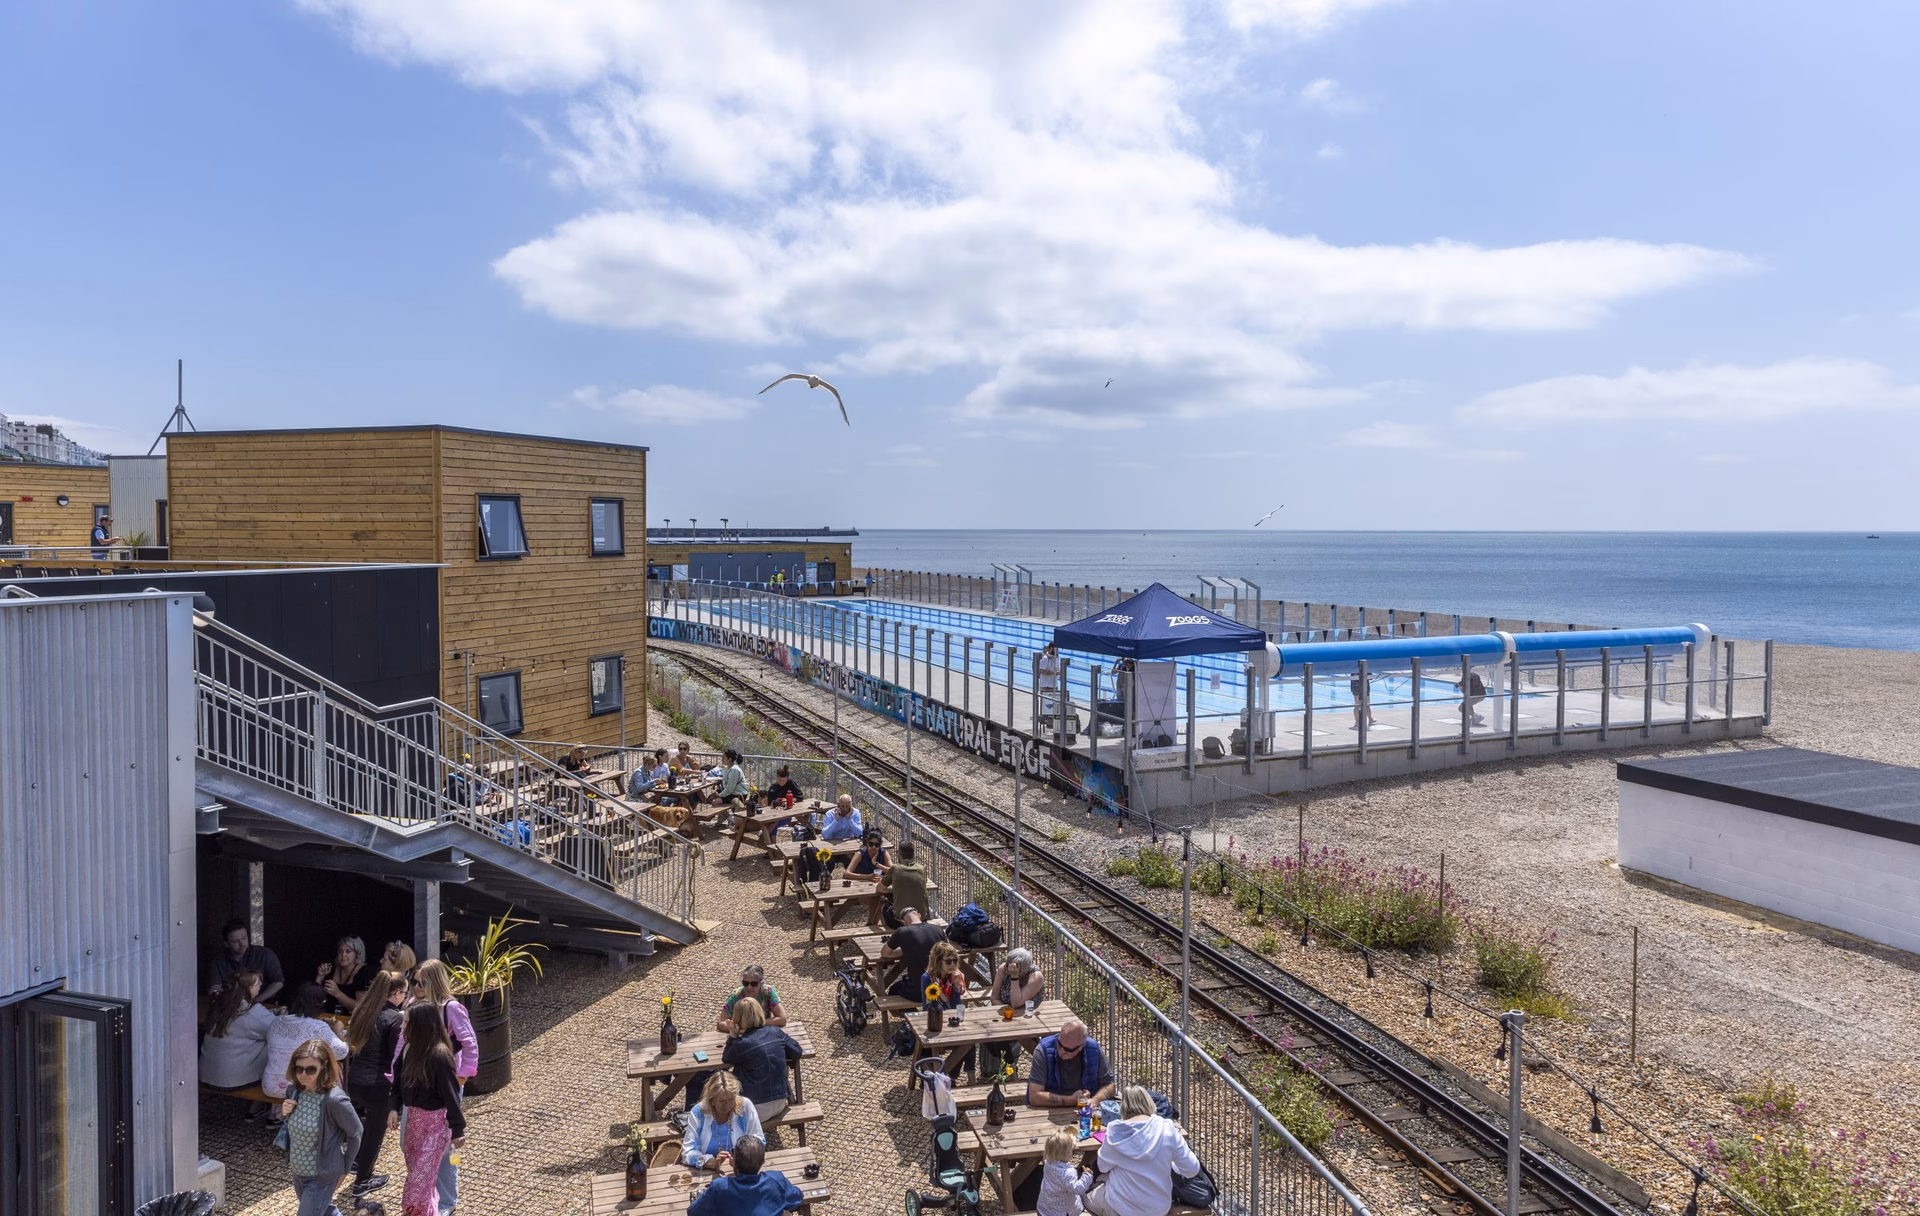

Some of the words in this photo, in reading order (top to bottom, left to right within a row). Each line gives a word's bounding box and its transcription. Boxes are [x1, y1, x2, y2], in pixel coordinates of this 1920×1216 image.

[649, 618, 675, 638] CITY
[680, 621, 704, 642] WITH
[706, 626, 721, 644] THE
[722, 630, 756, 653] NATURAL
[1166, 615, 1210, 628] ZOGGS
[926, 704, 996, 757] NATURAL
[1000, 730, 1051, 779] EDGE
